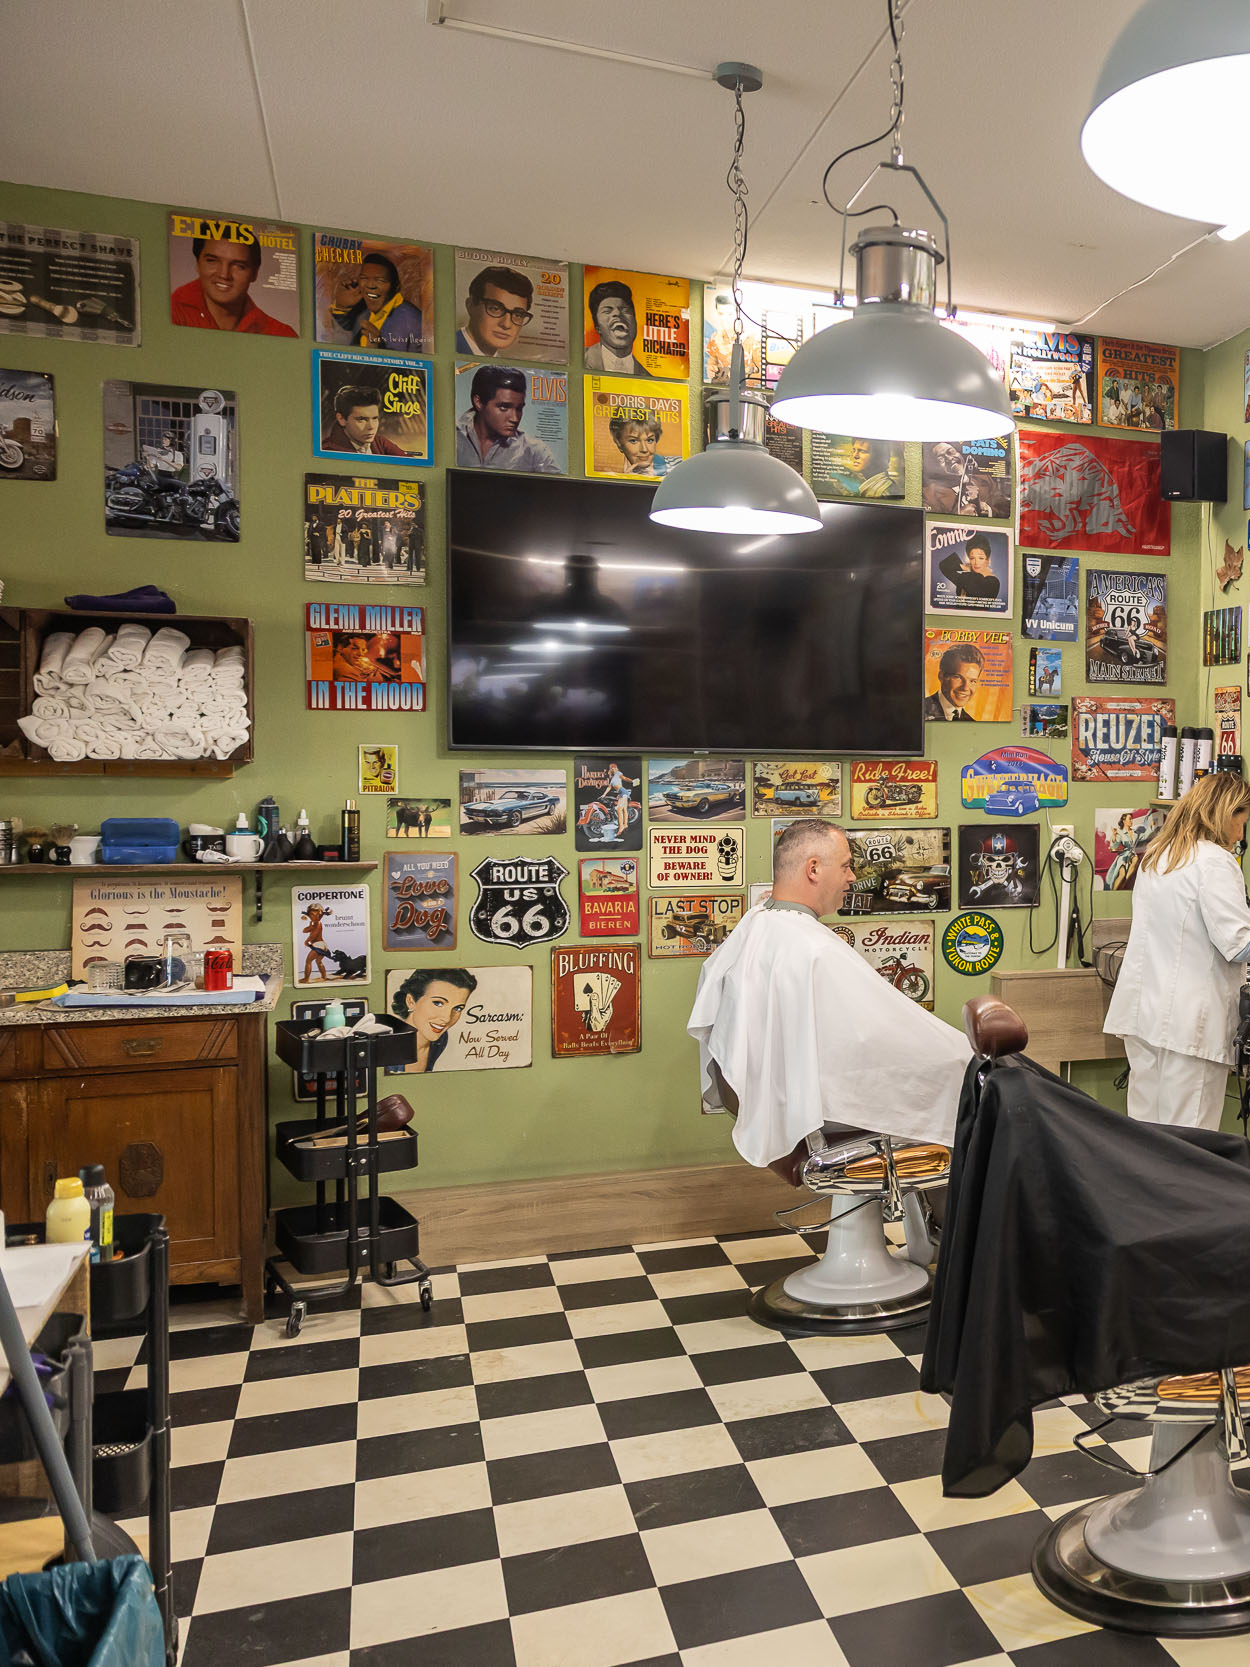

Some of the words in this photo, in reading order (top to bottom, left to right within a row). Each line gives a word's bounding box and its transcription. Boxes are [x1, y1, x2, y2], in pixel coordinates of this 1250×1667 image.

[171, 215, 255, 245] ELVIS
[259, 235, 296, 251] HOTEL
[320, 234, 363, 250] CHUBBY
[315, 247, 363, 265] CHECKER
[458, 251, 494, 263] BUDDY
[497, 254, 530, 268] HOLLY
[542, 272, 560, 285] 20
[646, 312, 680, 329] HERE'S
[643, 325, 677, 342] LITTLE
[643, 339, 686, 357] RICHARD
[1102, 348, 1176, 368] GREATEST
[388, 373, 420, 394] Cliff
[1123, 369, 1156, 383] HITS
[531, 376, 566, 403] ELVIS
[384, 392, 420, 418] Sings
[609, 394, 645, 408] DORIS
[650, 398, 679, 412] DAY'S
[594, 405, 650, 421] GREATEST
[654, 410, 679, 424] HITS
[308, 485, 421, 509] PLATTERS
[1110, 595, 1143, 605] ROUTE
[310, 604, 359, 630] GLENN
[366, 606, 422, 632] MILLER
[940, 630, 980, 642] BOBBY
[983, 632, 1007, 644] VEE
[311, 681, 329, 708] IN
[335, 682, 367, 709] THE
[371, 683, 423, 710] MOOD
[1221, 735, 1234, 754] 66
[854, 763, 889, 781] Ride
[892, 763, 935, 781] Free!
[362, 785, 395, 793] PITRALON
[654, 835, 687, 843] NEVER
[690, 835, 716, 843] MIND
[662, 846, 682, 854] THE
[686, 846, 708, 854] DOG
[869, 846, 893, 862] 66
[493, 864, 549, 883] ROUTE
[664, 862, 706, 870] BEWARE
[657, 873, 670, 881] OF
[673, 872, 713, 881] OWNER!
[853, 878, 877, 892] DRIVE
[90, 888, 133, 901] Glorious
[136, 888, 146, 899] is
[149, 888, 165, 898] the
[169, 886, 227, 899] Moustache!
[391, 876, 449, 897] Love
[504, 889, 538, 900] US
[297, 890, 365, 901] COPPERTONE
[585, 900, 636, 914] BAVARIA
[654, 900, 695, 915] LAST
[700, 899, 740, 914] STOP
[391, 903, 447, 939] Dog
[491, 905, 550, 937] 66
[590, 921, 631, 929] BIEREN
[862, 927, 930, 947] Indian
[559, 952, 634, 976] BLUFFING
[946, 948, 973, 972] YUKON
[976, 946, 1000, 972] ROUTE
[466, 1005, 524, 1024] Sarcasm:
[459, 1031, 482, 1044] Now
[485, 1030, 519, 1043] Served
[465, 1045, 484, 1058] All
[486, 1047, 510, 1062] Day
